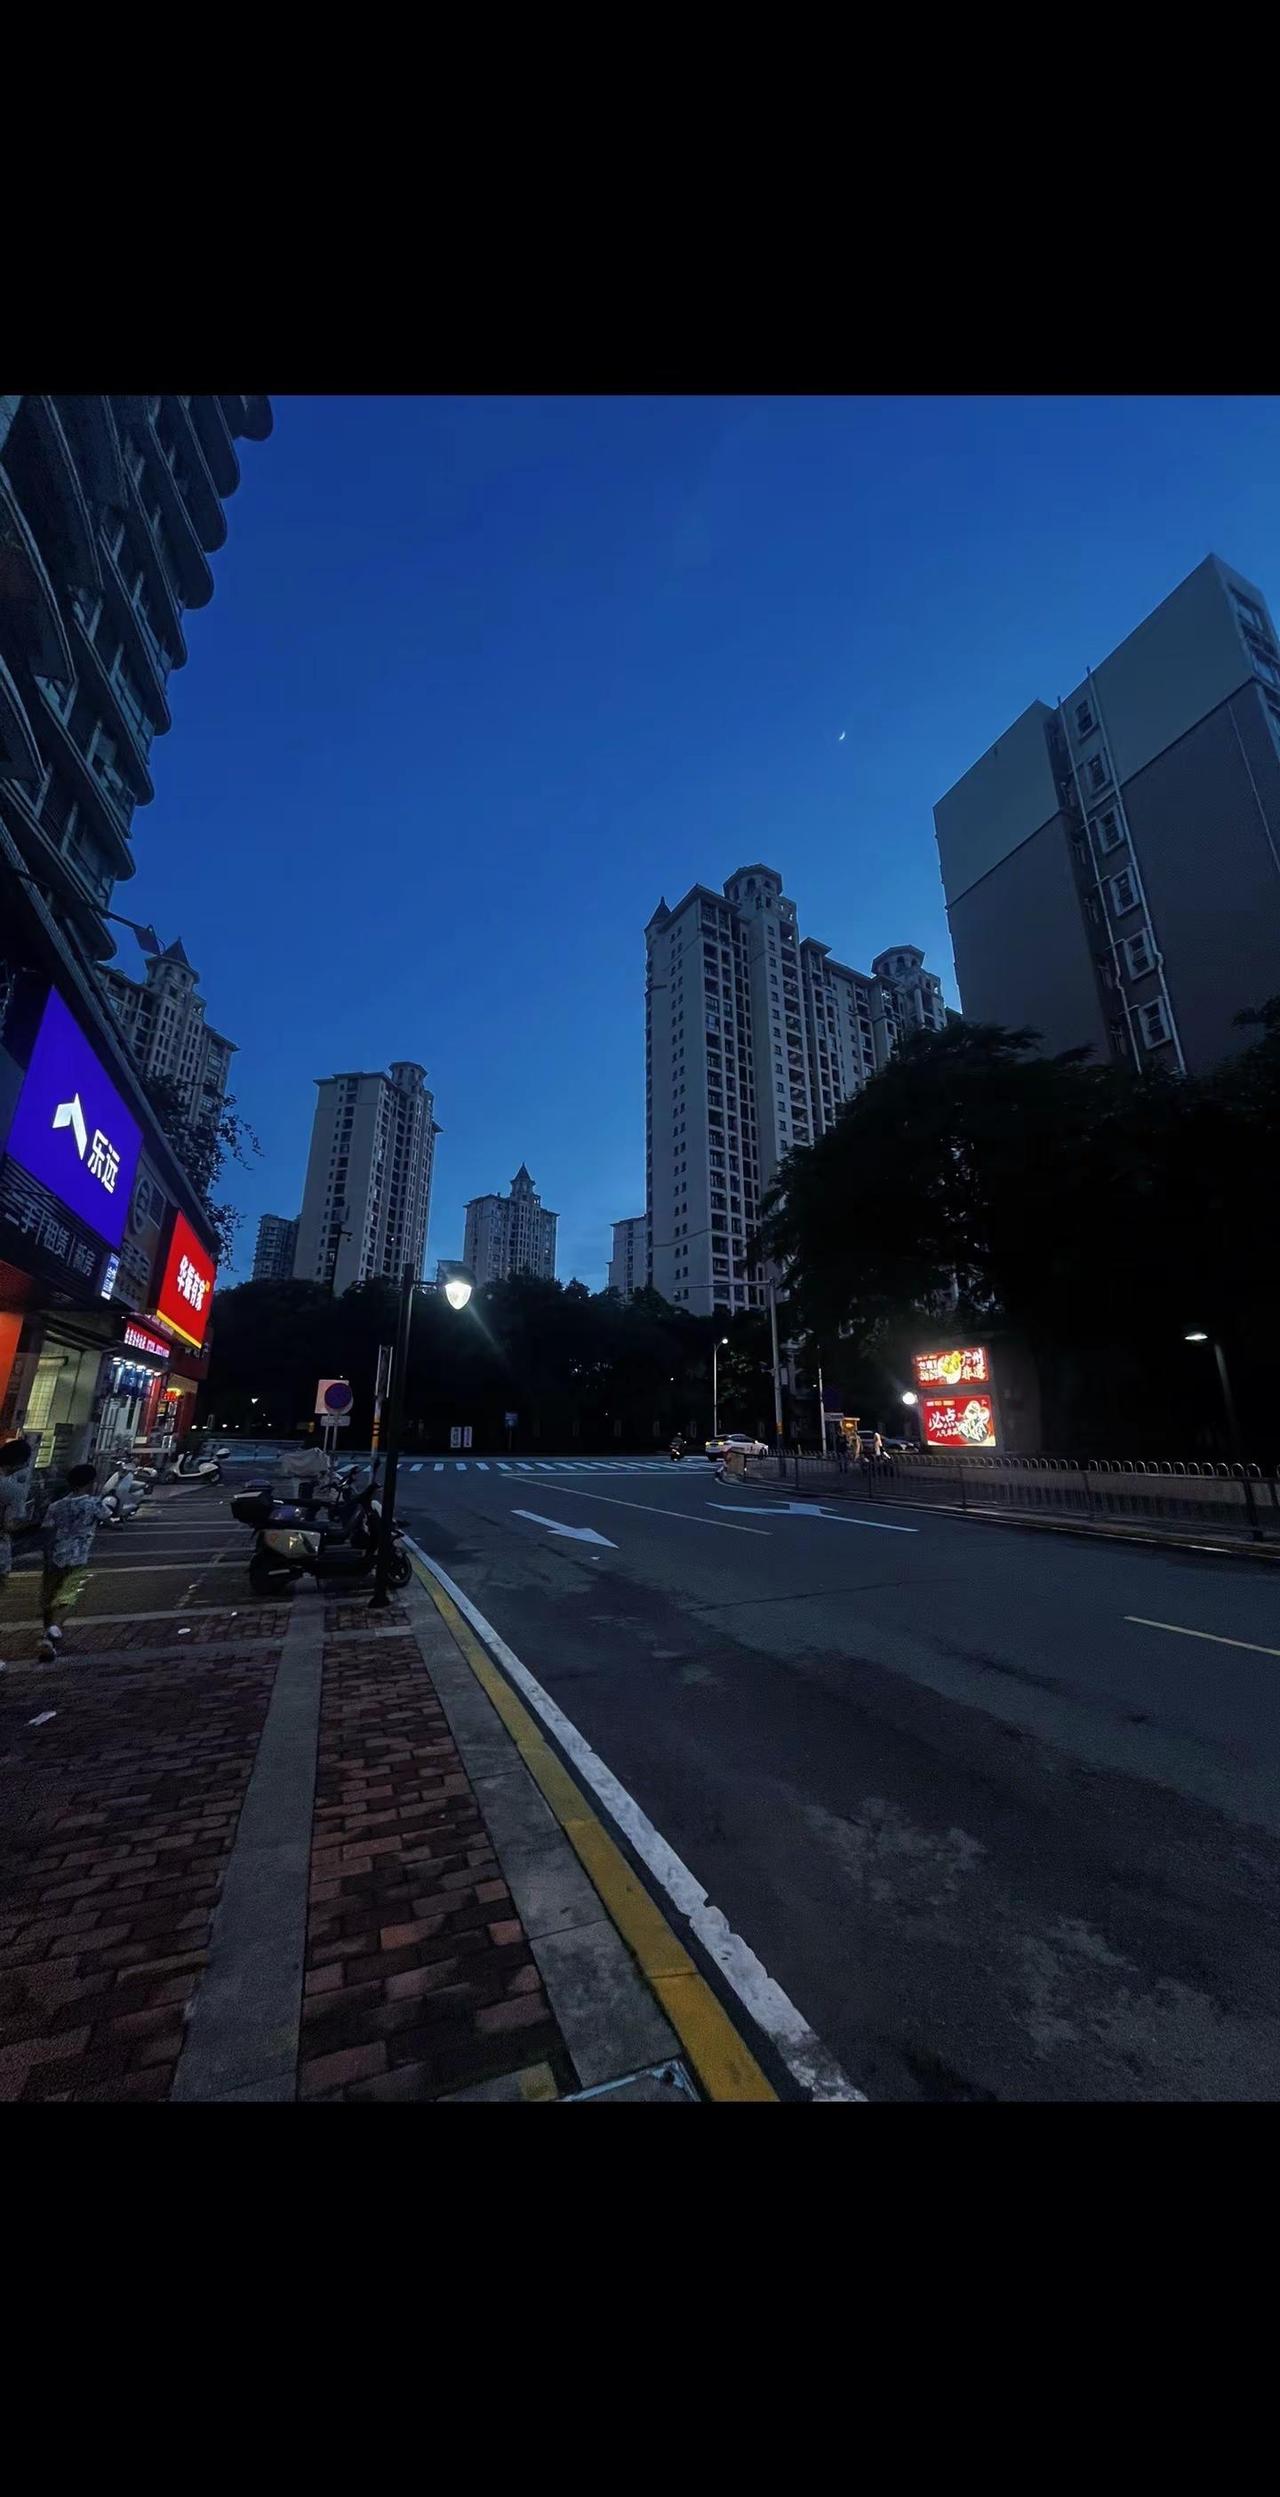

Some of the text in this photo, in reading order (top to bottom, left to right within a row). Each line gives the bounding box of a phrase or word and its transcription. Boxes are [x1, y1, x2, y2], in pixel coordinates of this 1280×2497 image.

[88, 1129, 120, 1194] 乐远
[43, 1219, 71, 1259] 租赁
[929, 1408, 958, 1431] 必点
